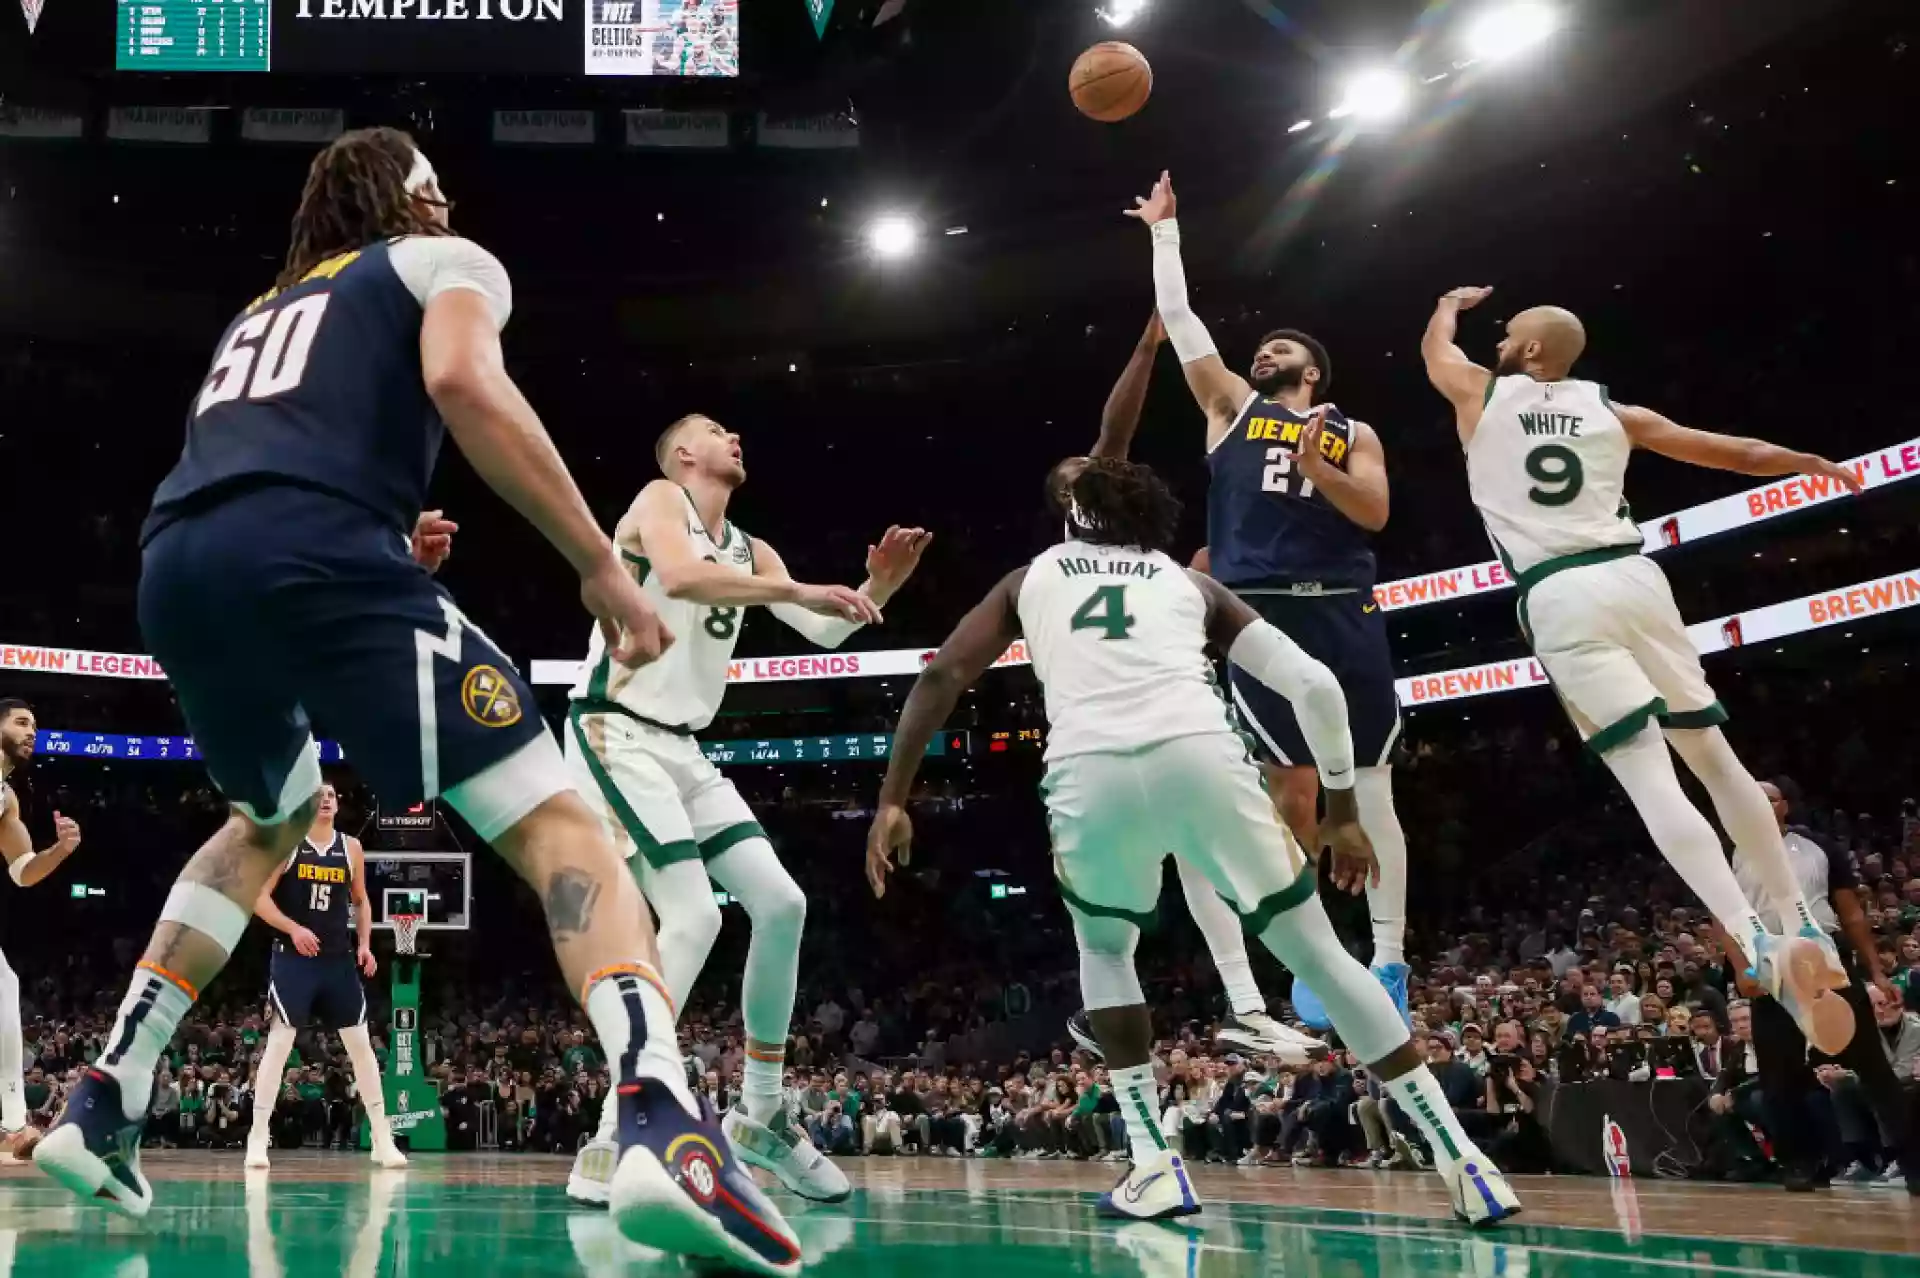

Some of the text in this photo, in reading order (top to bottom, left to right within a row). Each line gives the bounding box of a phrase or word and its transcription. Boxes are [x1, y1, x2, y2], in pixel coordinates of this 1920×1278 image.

[296, 0, 564, 21] TEMPLETON
[592, 27, 642, 46] CELTICS
[197, 292, 330, 416] 50
[1518, 412, 1583, 437] WHITE
[1246, 418, 1347, 464] DENER
[1525, 444, 1583, 507] 9
[1057, 557, 1163, 580] HOLIDAY
[1070, 584, 1136, 641] 4
[0, 647, 70, 669] EWIN'
[754, 655, 859, 678] LEGENDS
[1411, 663, 1519, 700] BREWIN'
[395, 816, 432, 826] TISSOT
[298, 863, 345, 883] DENVER
[310, 883, 331, 911] 15
